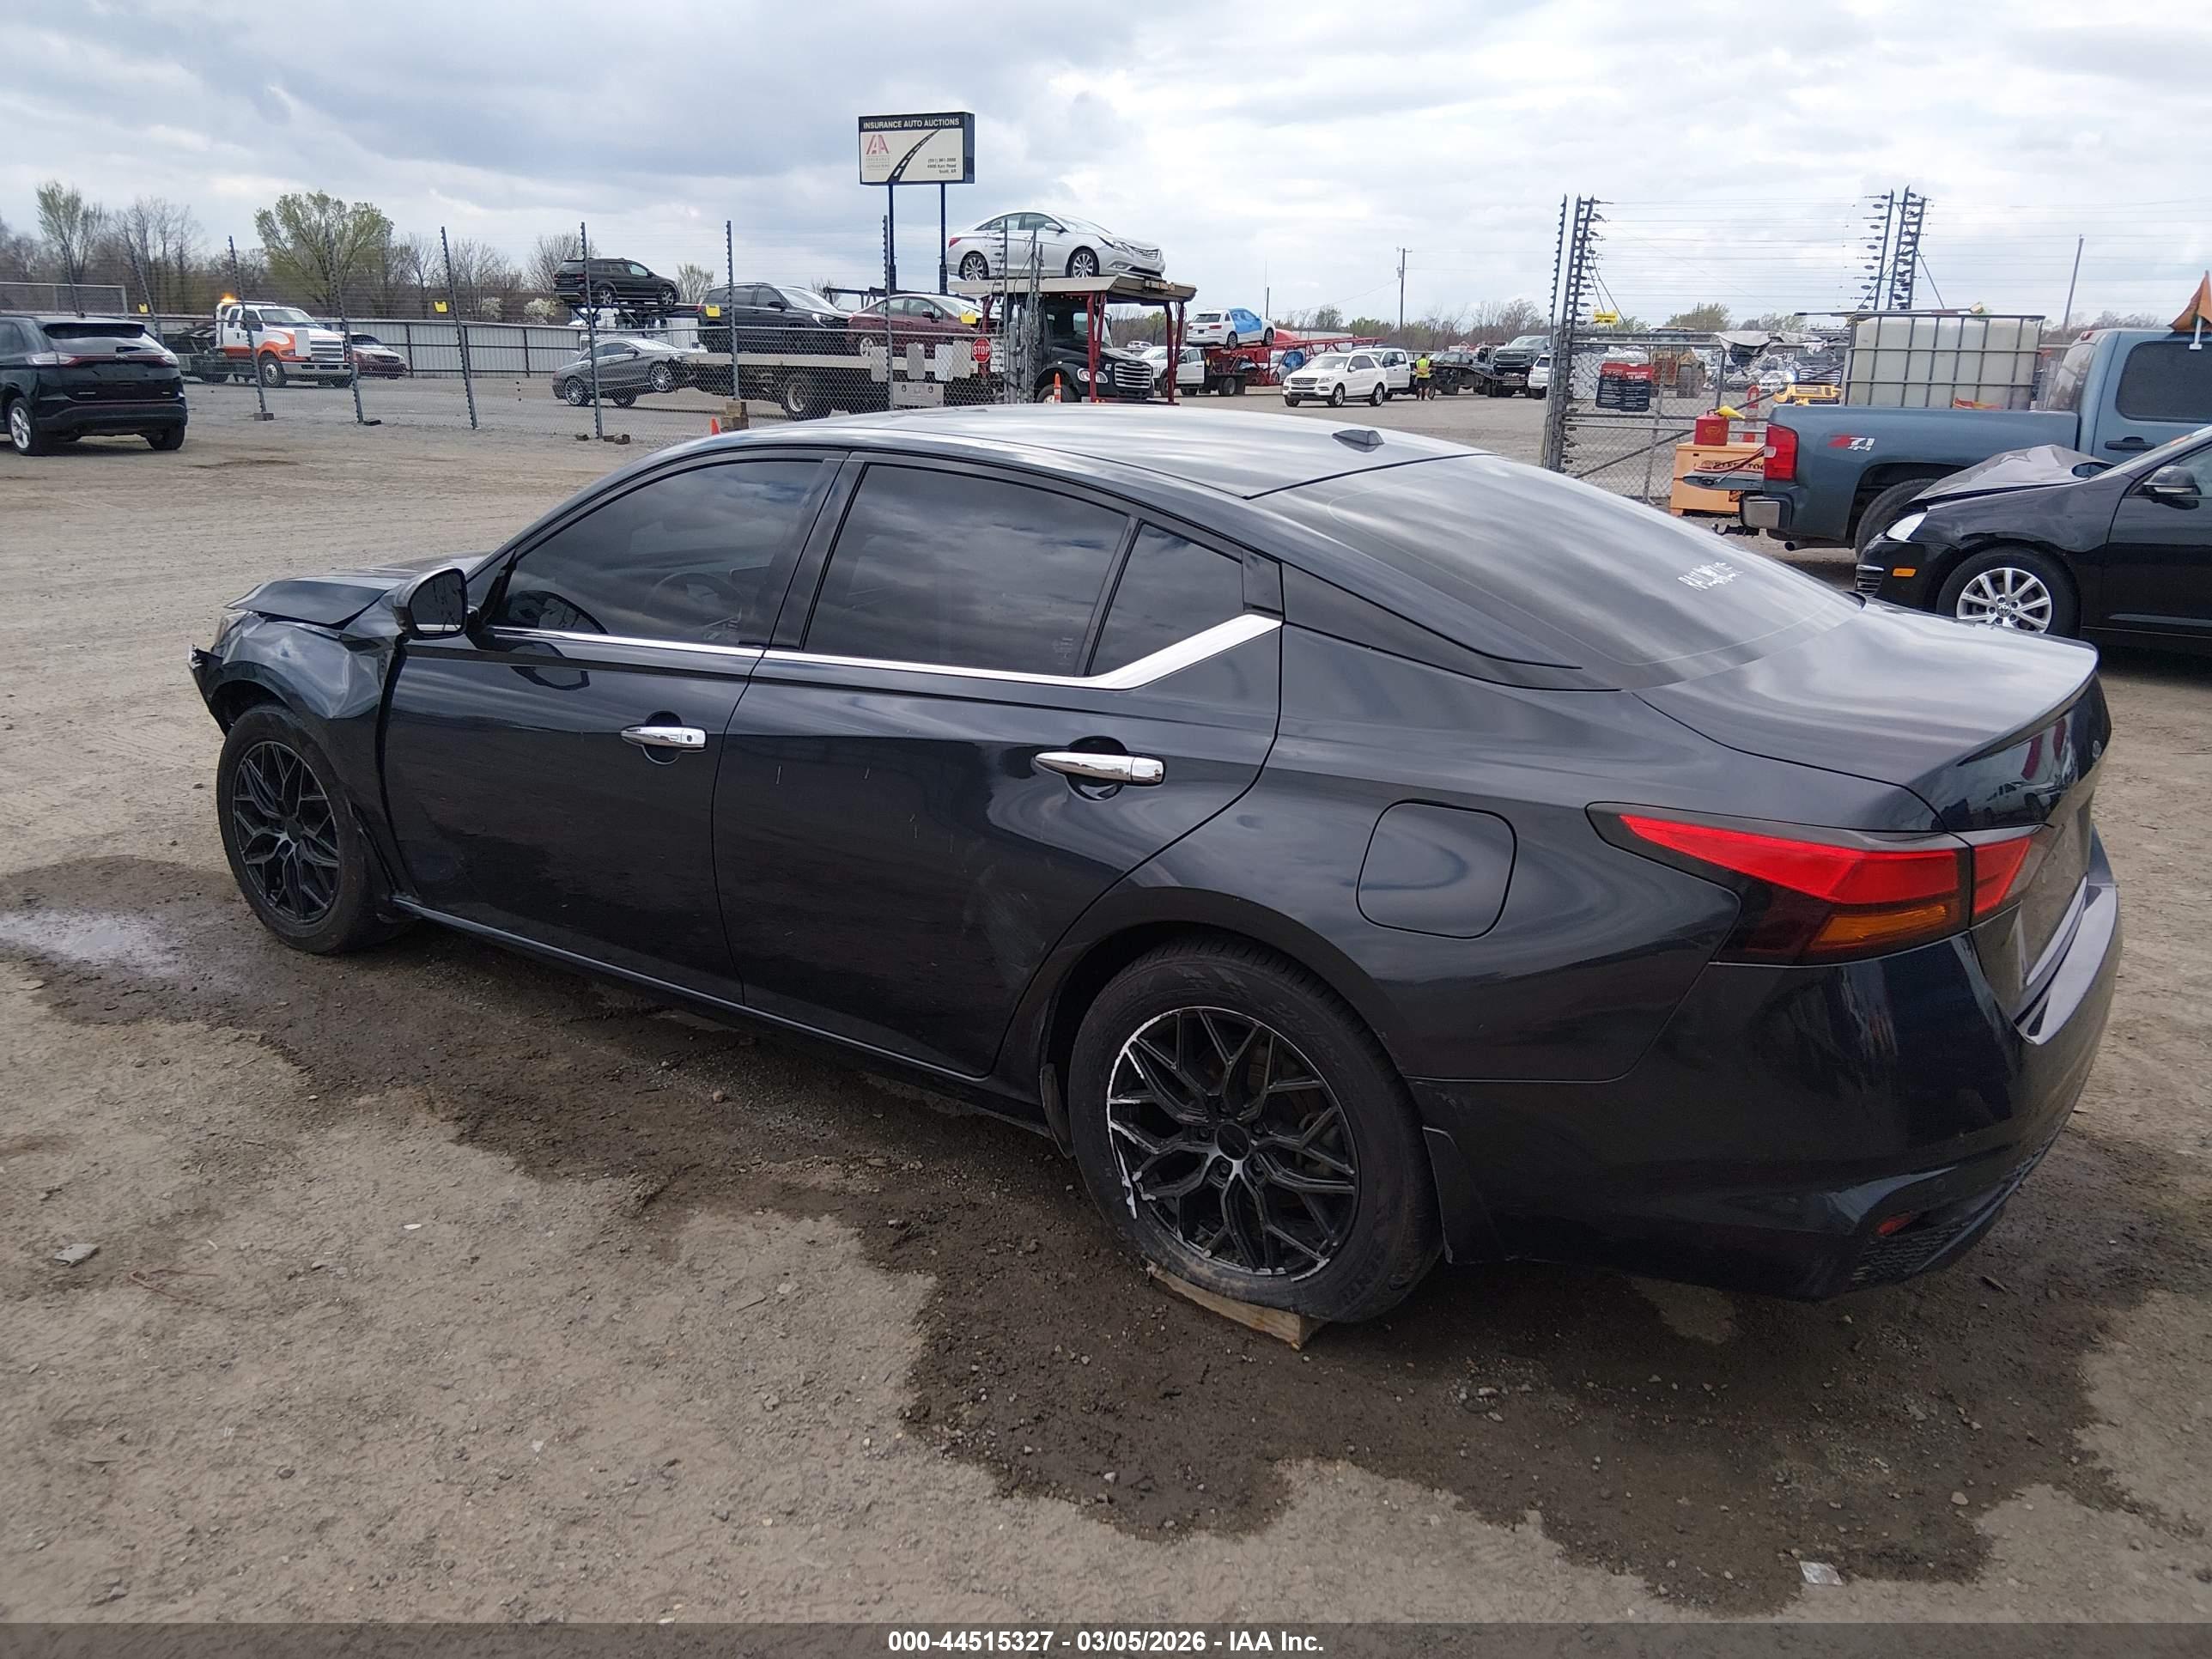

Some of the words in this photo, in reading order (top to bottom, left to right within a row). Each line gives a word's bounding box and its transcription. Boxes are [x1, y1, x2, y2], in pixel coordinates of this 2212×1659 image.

[903, 119, 922, 128] AUTO
[924, 118, 959, 127] AUCTIONS
[973, 345, 990, 355] STOP
